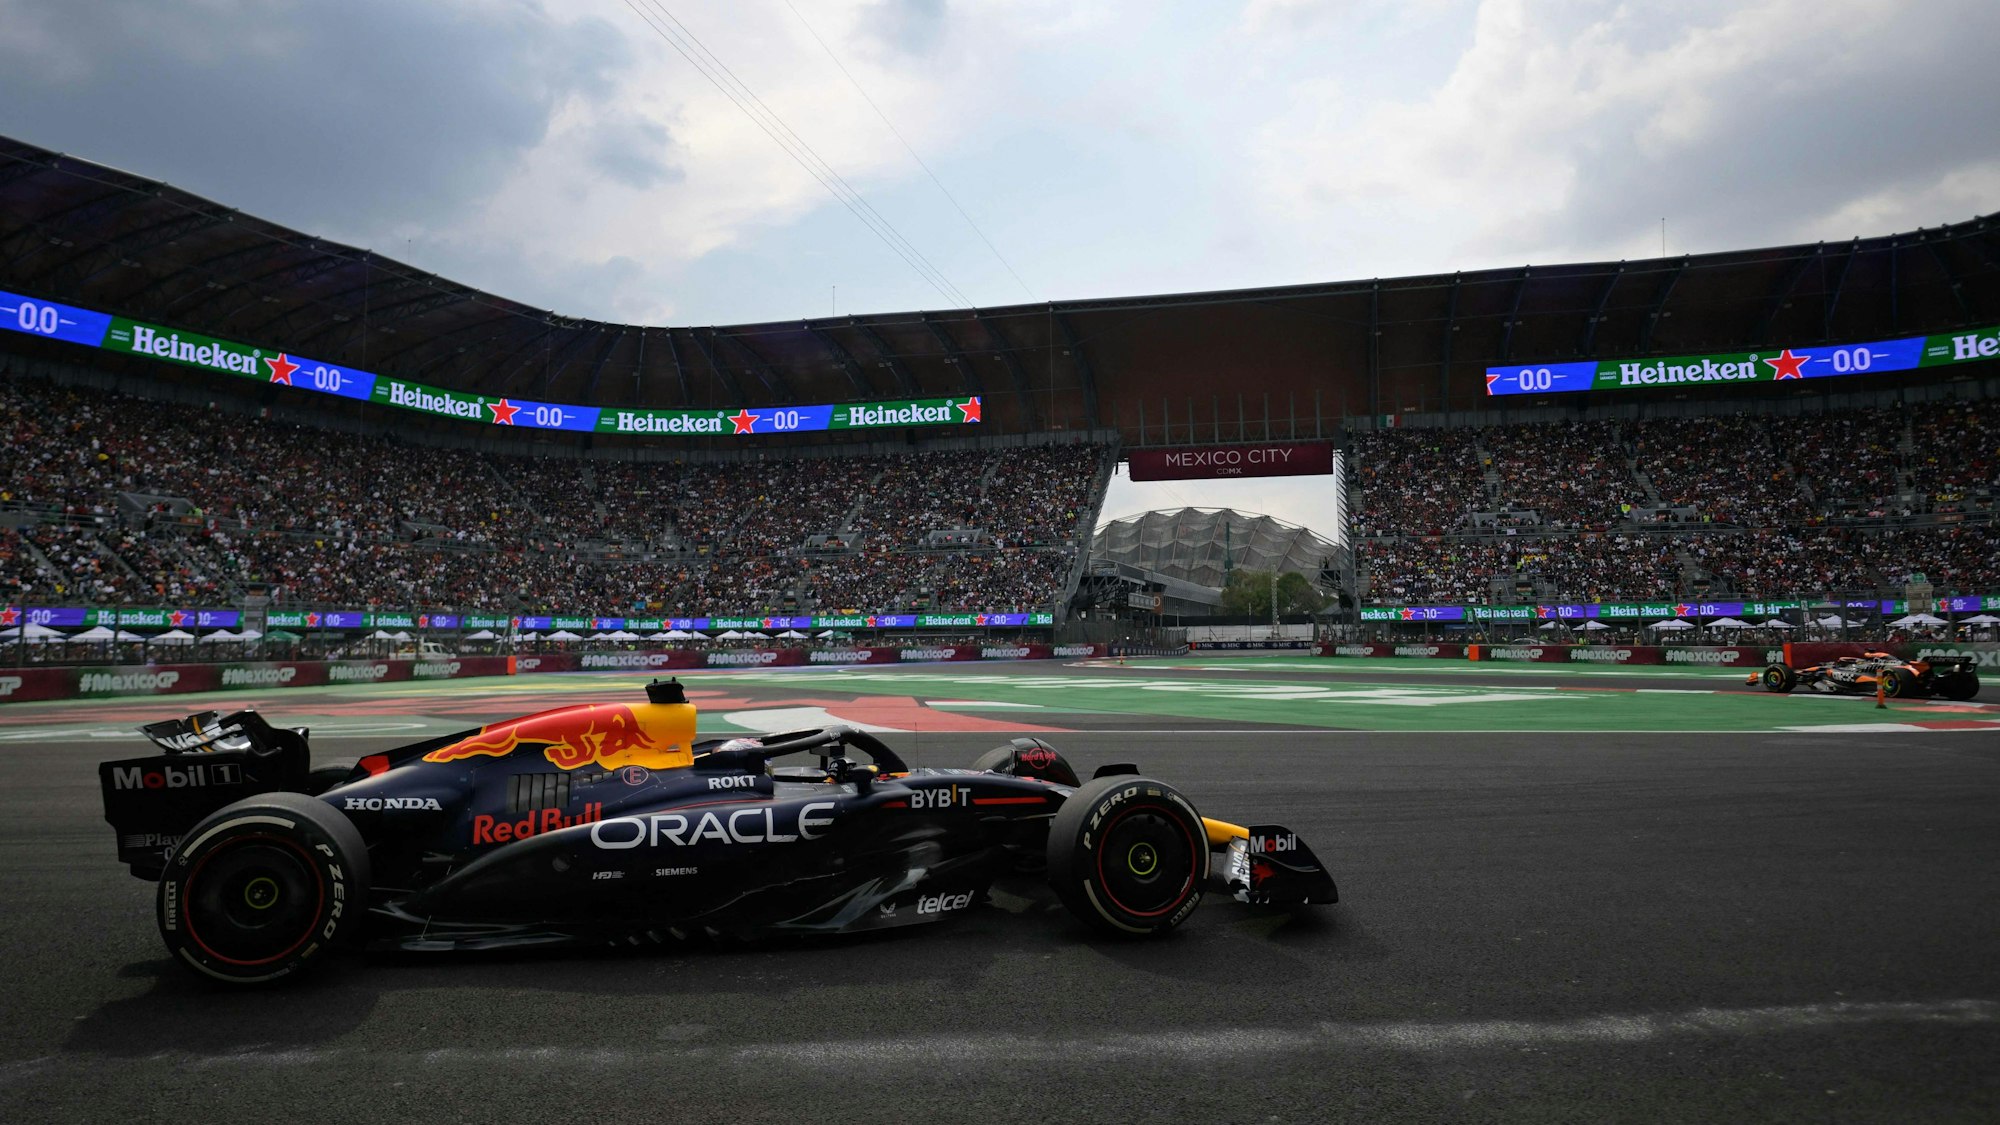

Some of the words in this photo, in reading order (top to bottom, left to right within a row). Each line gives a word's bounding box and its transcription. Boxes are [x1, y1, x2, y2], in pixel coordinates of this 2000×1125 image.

[19, 301, 58, 334] 0.0
[132, 325, 258, 375] Heineken
[315, 366, 341, 391] 0.0
[1833, 347, 1871, 373] 0.0
[1519, 368, 1552, 391] 0.0
[1619, 358, 1757, 386] Heineken
[389, 382, 482, 418] Heineken
[535, 405, 563, 427] 0.0
[617, 412, 722, 433] Heineken
[774, 410, 799, 430] 0.0
[849, 403, 952, 426] Heineken
[1165, 450, 1241, 467] MEXICO
[1248, 448, 1293, 464] CITY
[1216, 467, 1242, 475] CDMX
[97, 610, 163, 625] Heneken
[267, 613, 301, 626] neken
[1360, 609, 1395, 620] neken
[707, 652, 777, 664] #MexicoGP
[809, 650, 872, 662] #MexicoGP
[900, 648, 956, 660] #MexicoGP
[981, 648, 1030, 659] #MexicoGP
[1053, 646, 1095, 657] #MexicoGP
[1335, 646, 1374, 655] #MexicoGP
[1394, 646, 1440, 656] #MexicoGP
[1490, 648, 1543, 660] #MexicoGP
[1570, 648, 1632, 661] #MexicoGP
[1665, 649, 1740, 663] #MexicoGP
[413, 662, 461, 676] #MexicoGP
[581, 654, 669, 668] #MexicoGP
[222, 667, 296, 685] #MexicoGP
[329, 664, 388, 681] #MexicoGP
[79, 671, 180, 692] #MexicoGP
[113, 765, 206, 790] Mobil
[708, 774, 756, 790] ROKT
[344, 797, 442, 811] HONDA
[911, 783, 971, 809] BYBIT
[473, 810, 535, 845] Red
[541, 802, 602, 833] Bull
[590, 801, 836, 850] ORACLE
[1083, 832, 1092, 850] P
[1090, 786, 1138, 831] ZERO
[145, 833, 182, 848] Play
[1250, 833, 1297, 854] Mobil
[315, 843, 334, 858] P
[655, 866, 698, 877] SIEMENS
[164, 881, 177, 931] PIRELLI
[322, 864, 345, 939] ZERO
[916, 889, 975, 915] telcel
